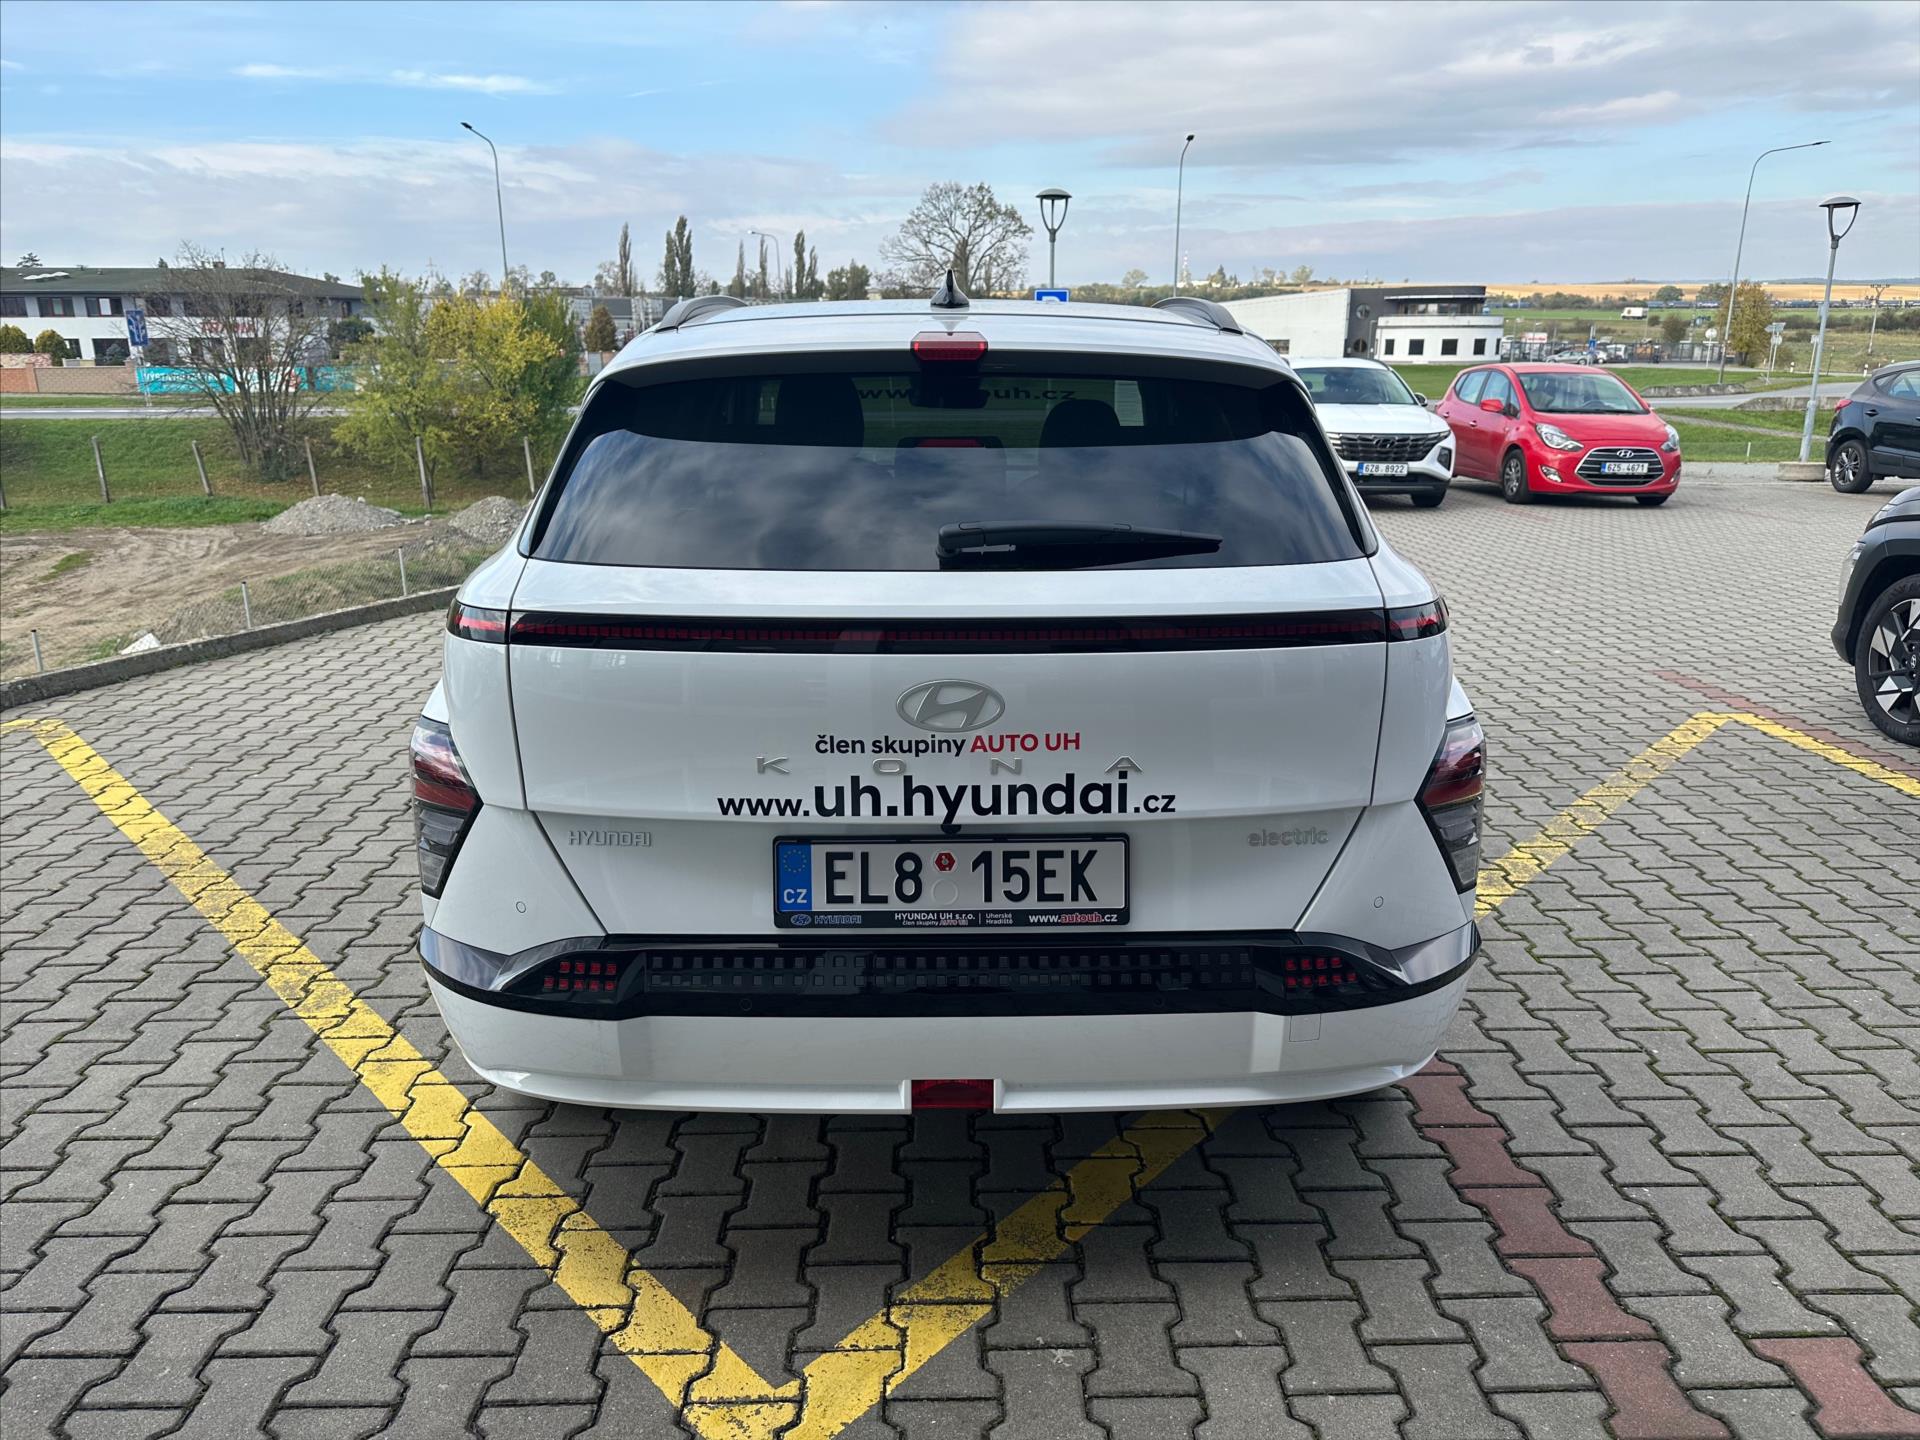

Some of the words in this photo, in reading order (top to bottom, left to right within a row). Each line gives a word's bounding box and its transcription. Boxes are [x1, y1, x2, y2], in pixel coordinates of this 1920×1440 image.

[815, 734, 865, 754] člen
[871, 734, 966, 757] skupiny
[970, 734, 1038, 753] AUTO
[1044, 732, 1081, 751] UH
[755, 755, 1144, 776] KONA
[717, 772, 1175, 826] www.uh.hyundai.cz
[568, 830, 652, 847] HYUNDAI
[1247, 827, 1329, 847] electric
[826, 852, 923, 904] EL8
[972, 850, 1098, 903] 15EK
[784, 889, 808, 904] CZ
[815, 915, 862, 924] HYUNDAI
[895, 912, 938, 921] HYUNDAI
[941, 912, 953, 920] UH
[955, 912, 976, 921] s.r.o.
[1030, 912, 1118, 924] www.autouh.cz
